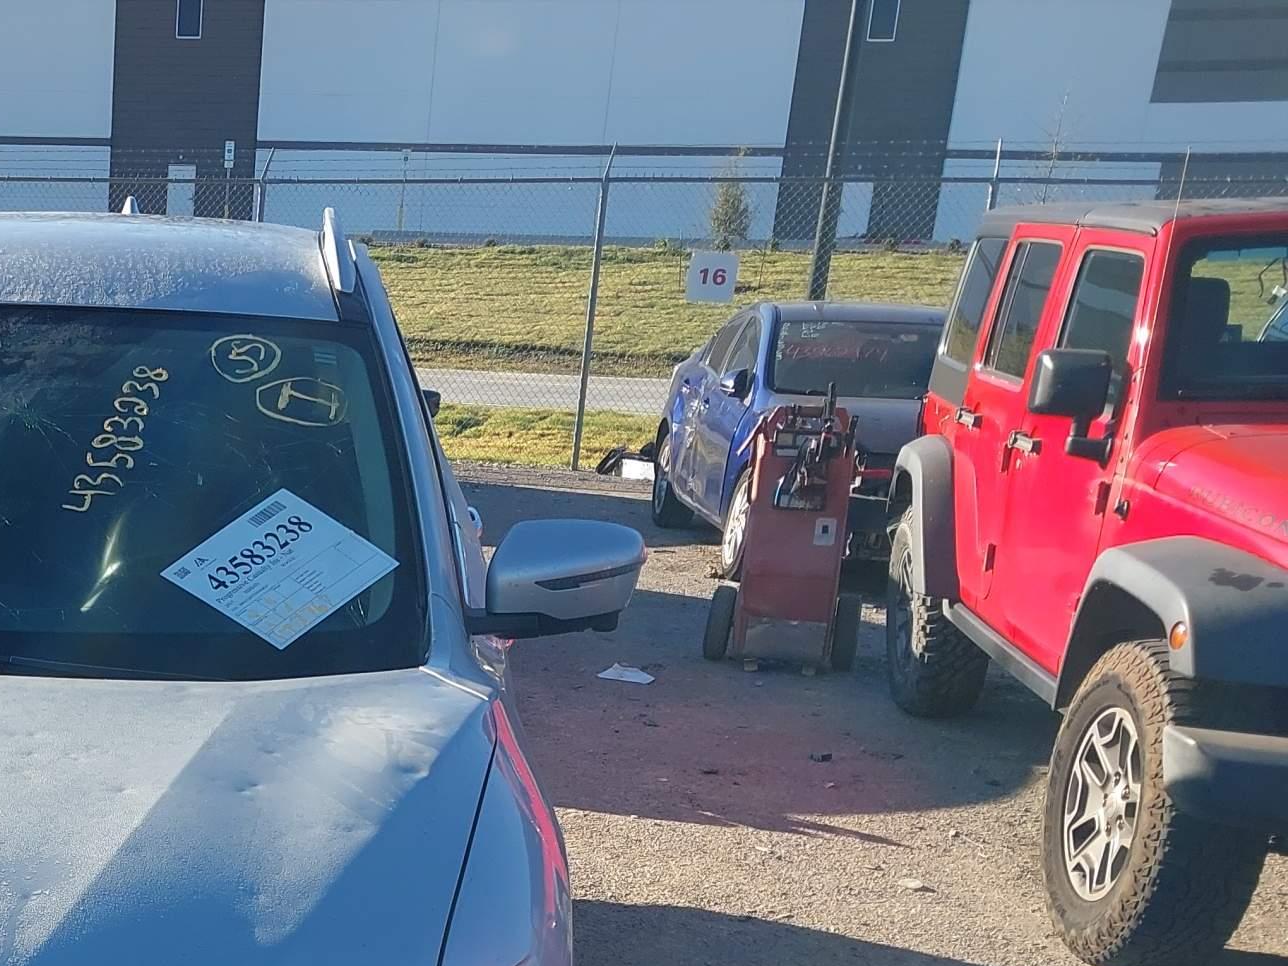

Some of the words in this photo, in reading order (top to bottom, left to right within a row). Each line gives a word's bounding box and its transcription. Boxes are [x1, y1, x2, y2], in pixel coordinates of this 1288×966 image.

[699, 267, 727, 286] 16
[62, 366, 168, 512] 43583238
[207, 515, 313, 592] 43583238
